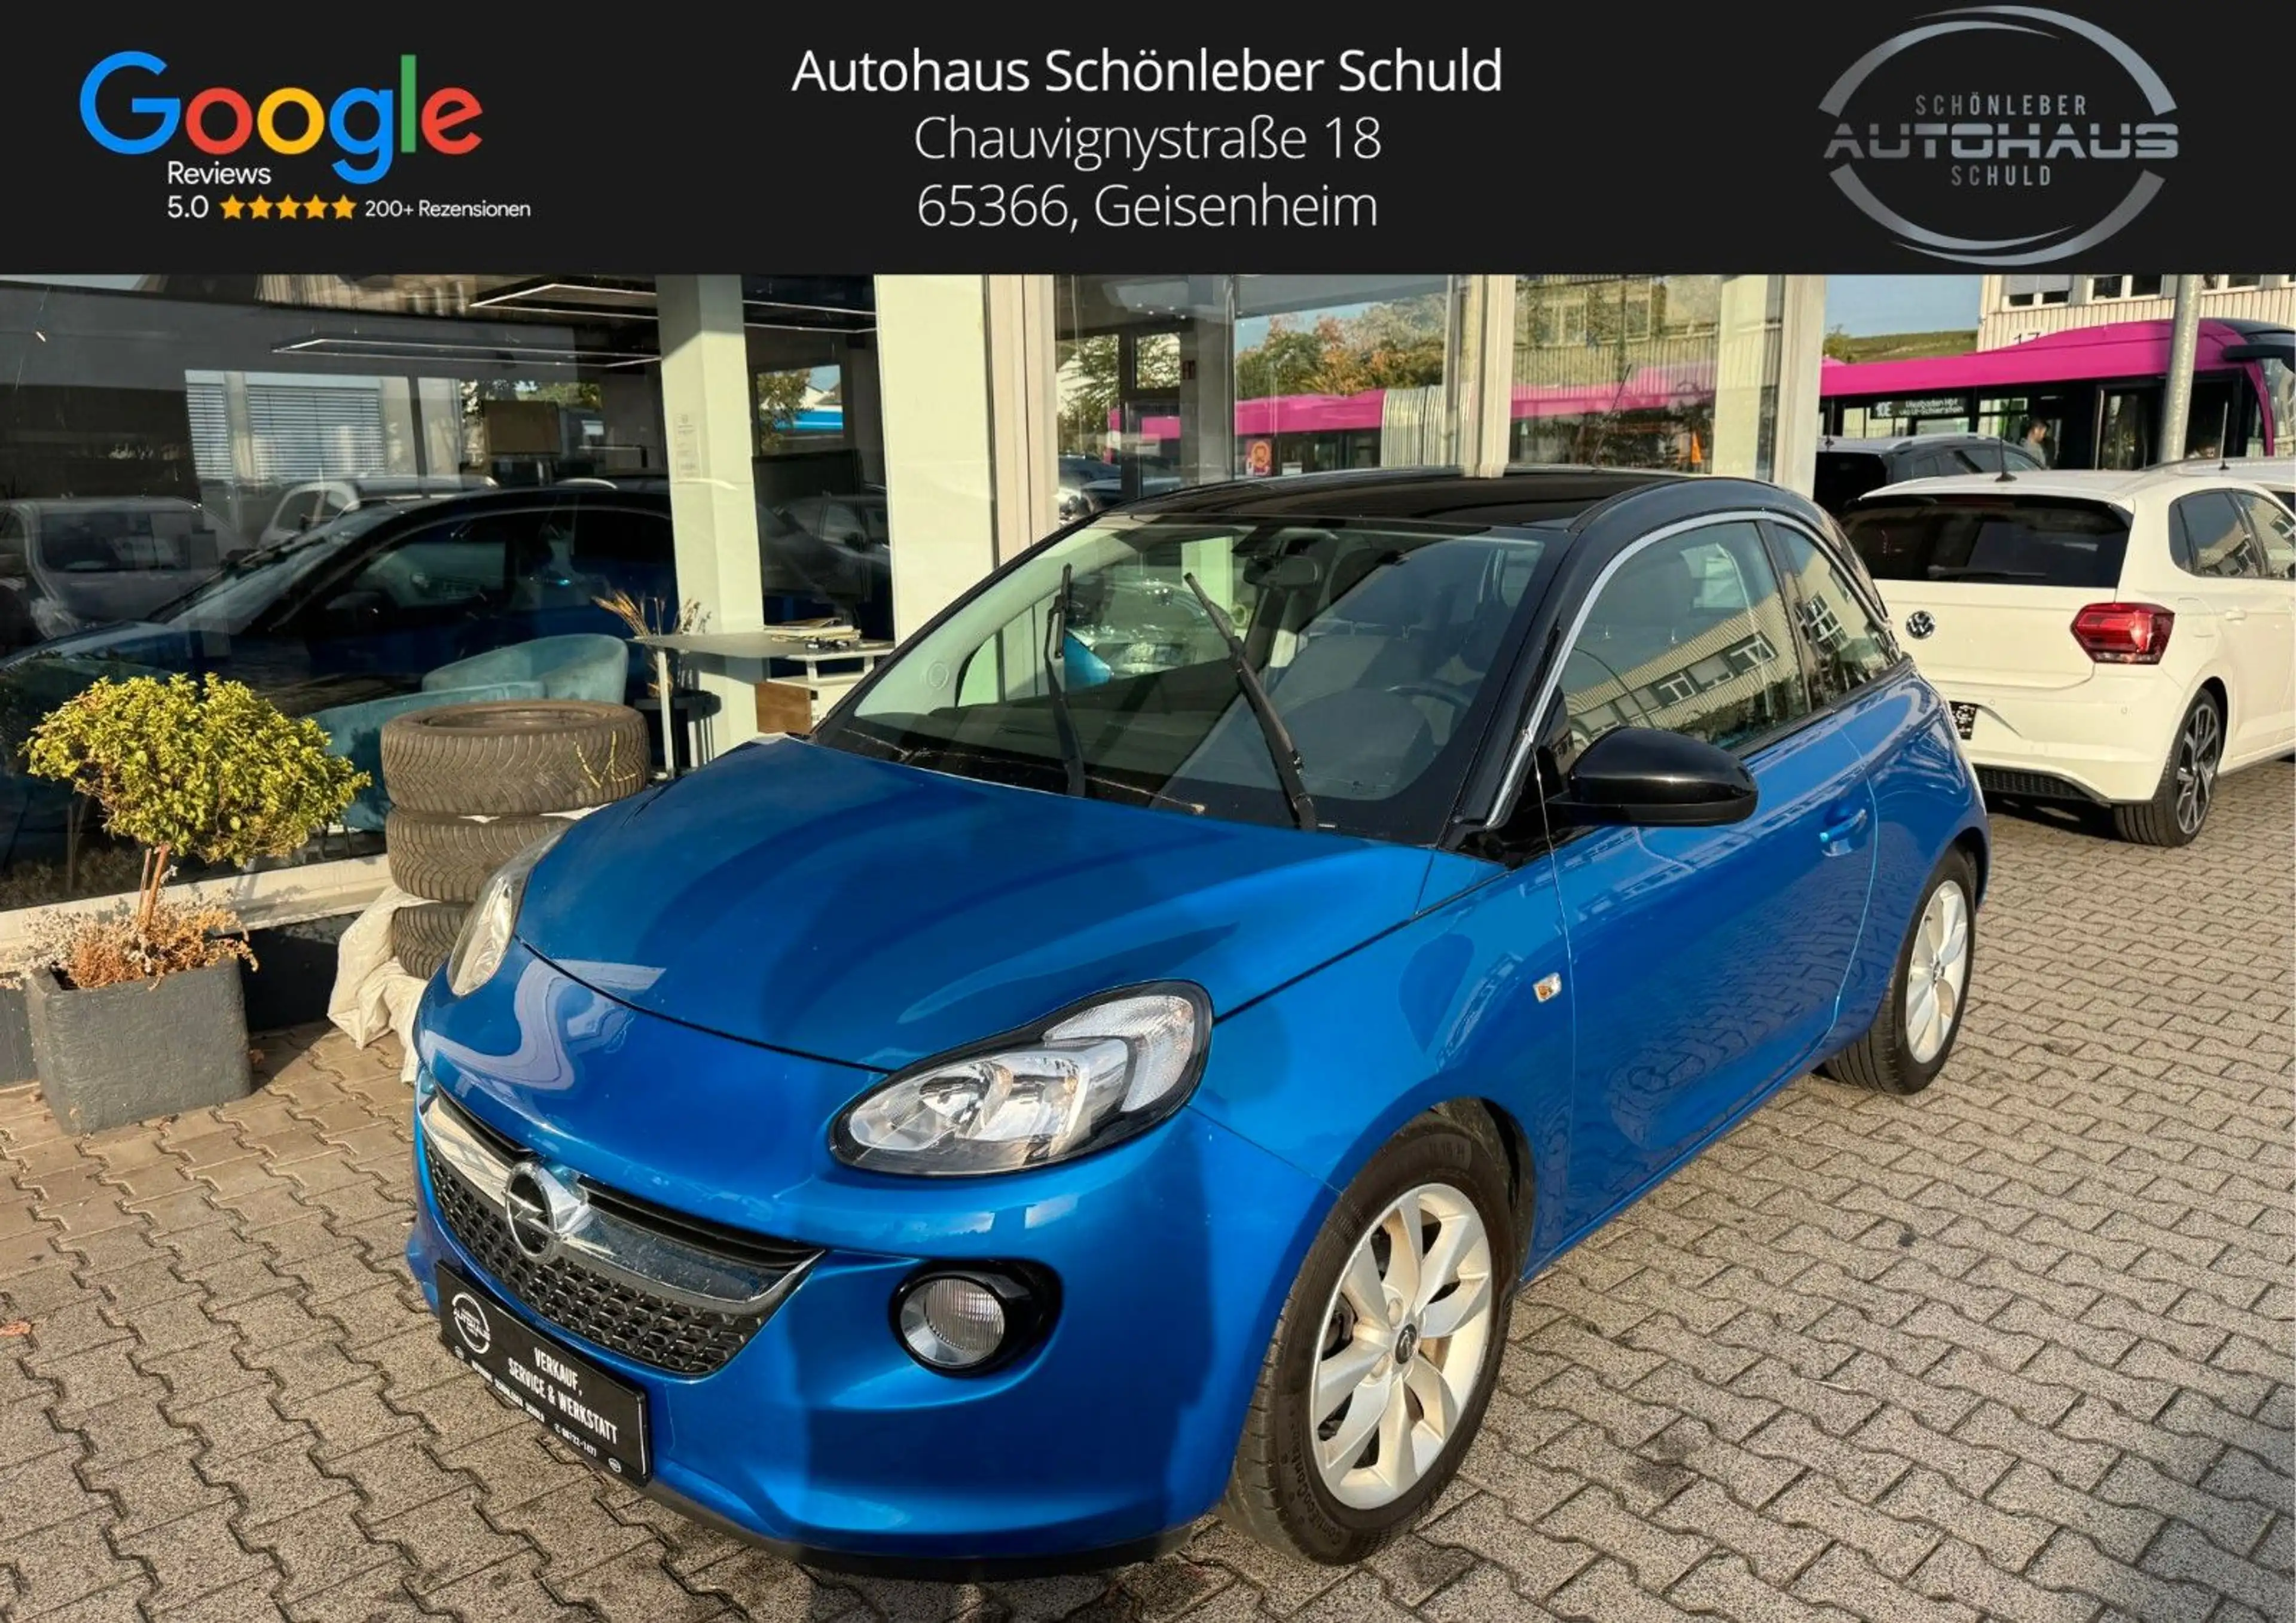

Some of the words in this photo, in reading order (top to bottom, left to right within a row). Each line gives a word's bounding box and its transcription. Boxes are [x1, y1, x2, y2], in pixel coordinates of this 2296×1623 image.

[508, 1357, 546, 1399] SERVICE
[548, 1384, 556, 1406] &
[558, 1390, 618, 1445] WERKSTATT
